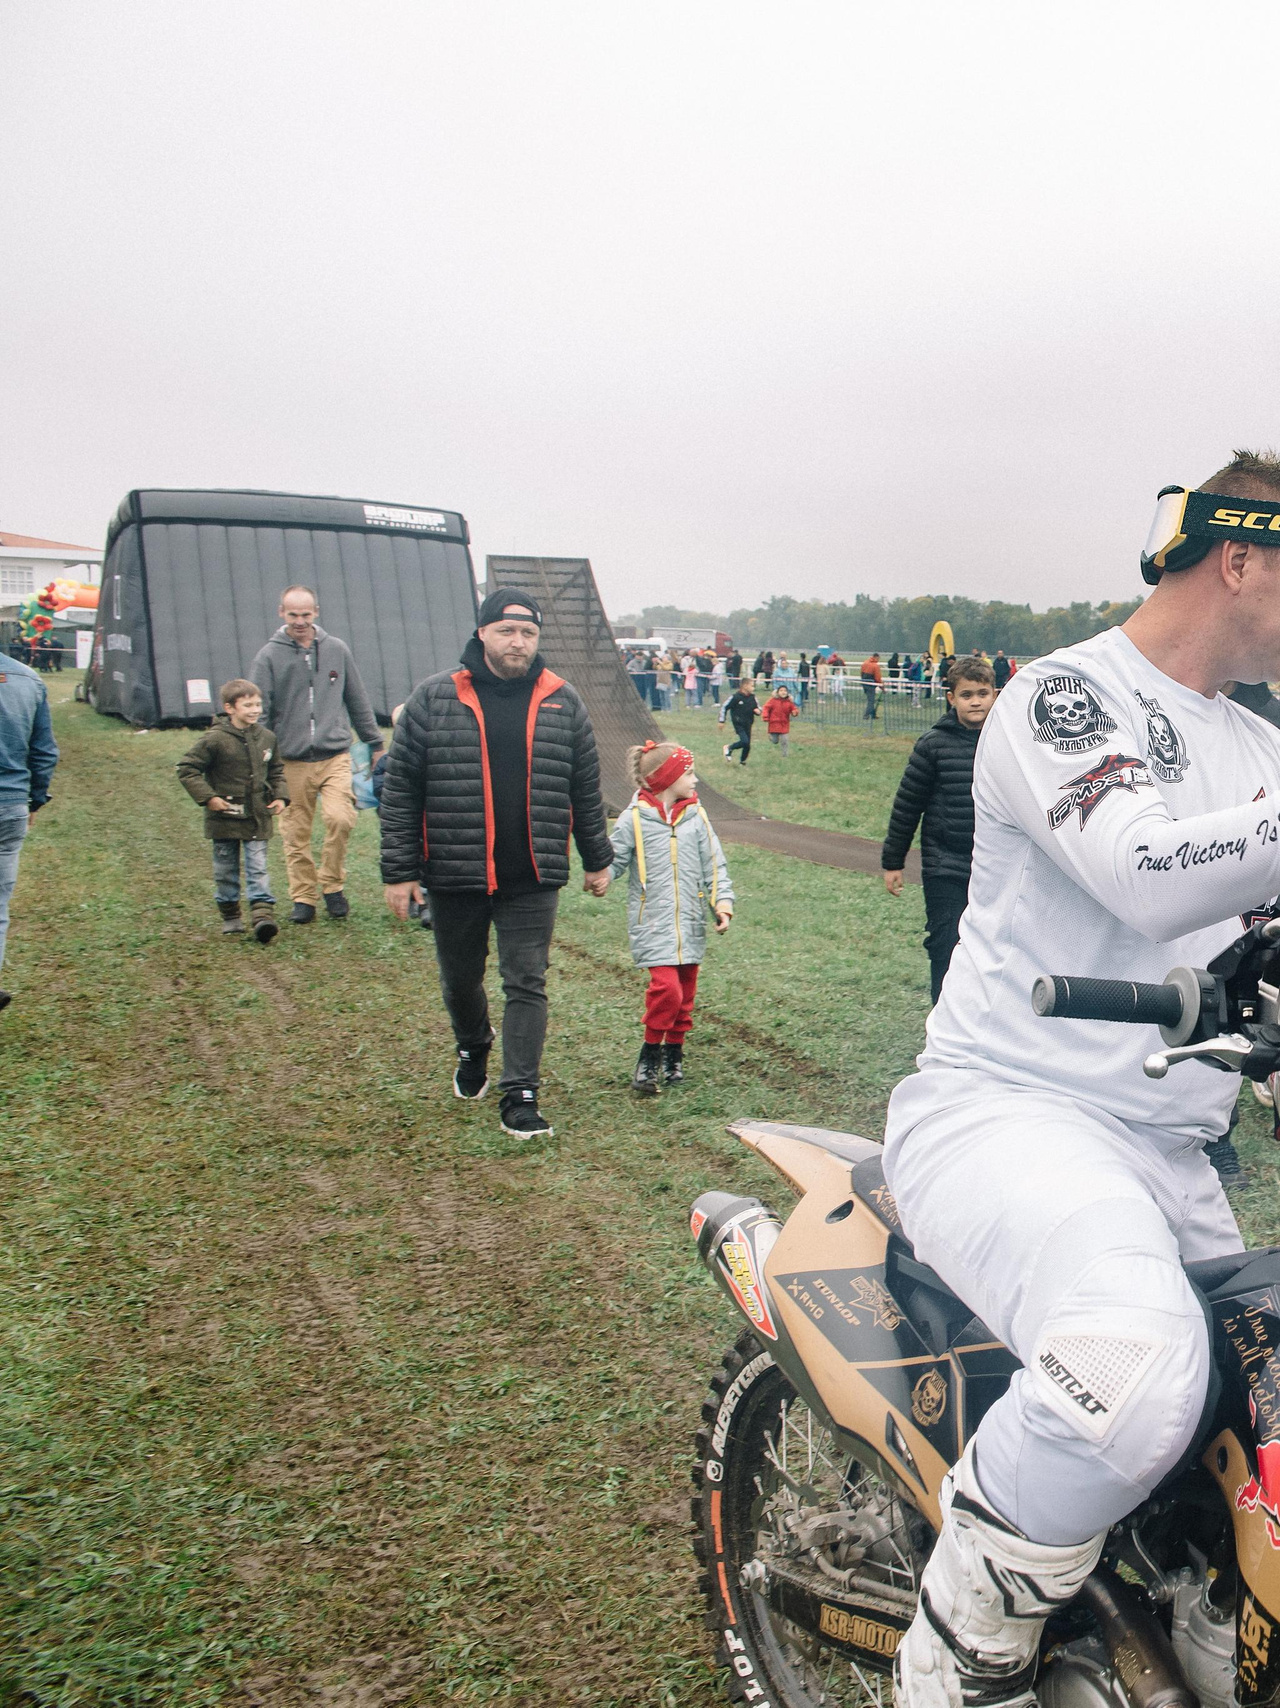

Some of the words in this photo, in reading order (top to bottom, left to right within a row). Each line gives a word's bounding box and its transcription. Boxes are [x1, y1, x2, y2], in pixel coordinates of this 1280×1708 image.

[1135, 845, 1173, 871] True
[1176, 837, 1248, 870] Victory
[812, 1279, 861, 1326] DUNLOP
[1244, 1294, 1274, 1344] True
